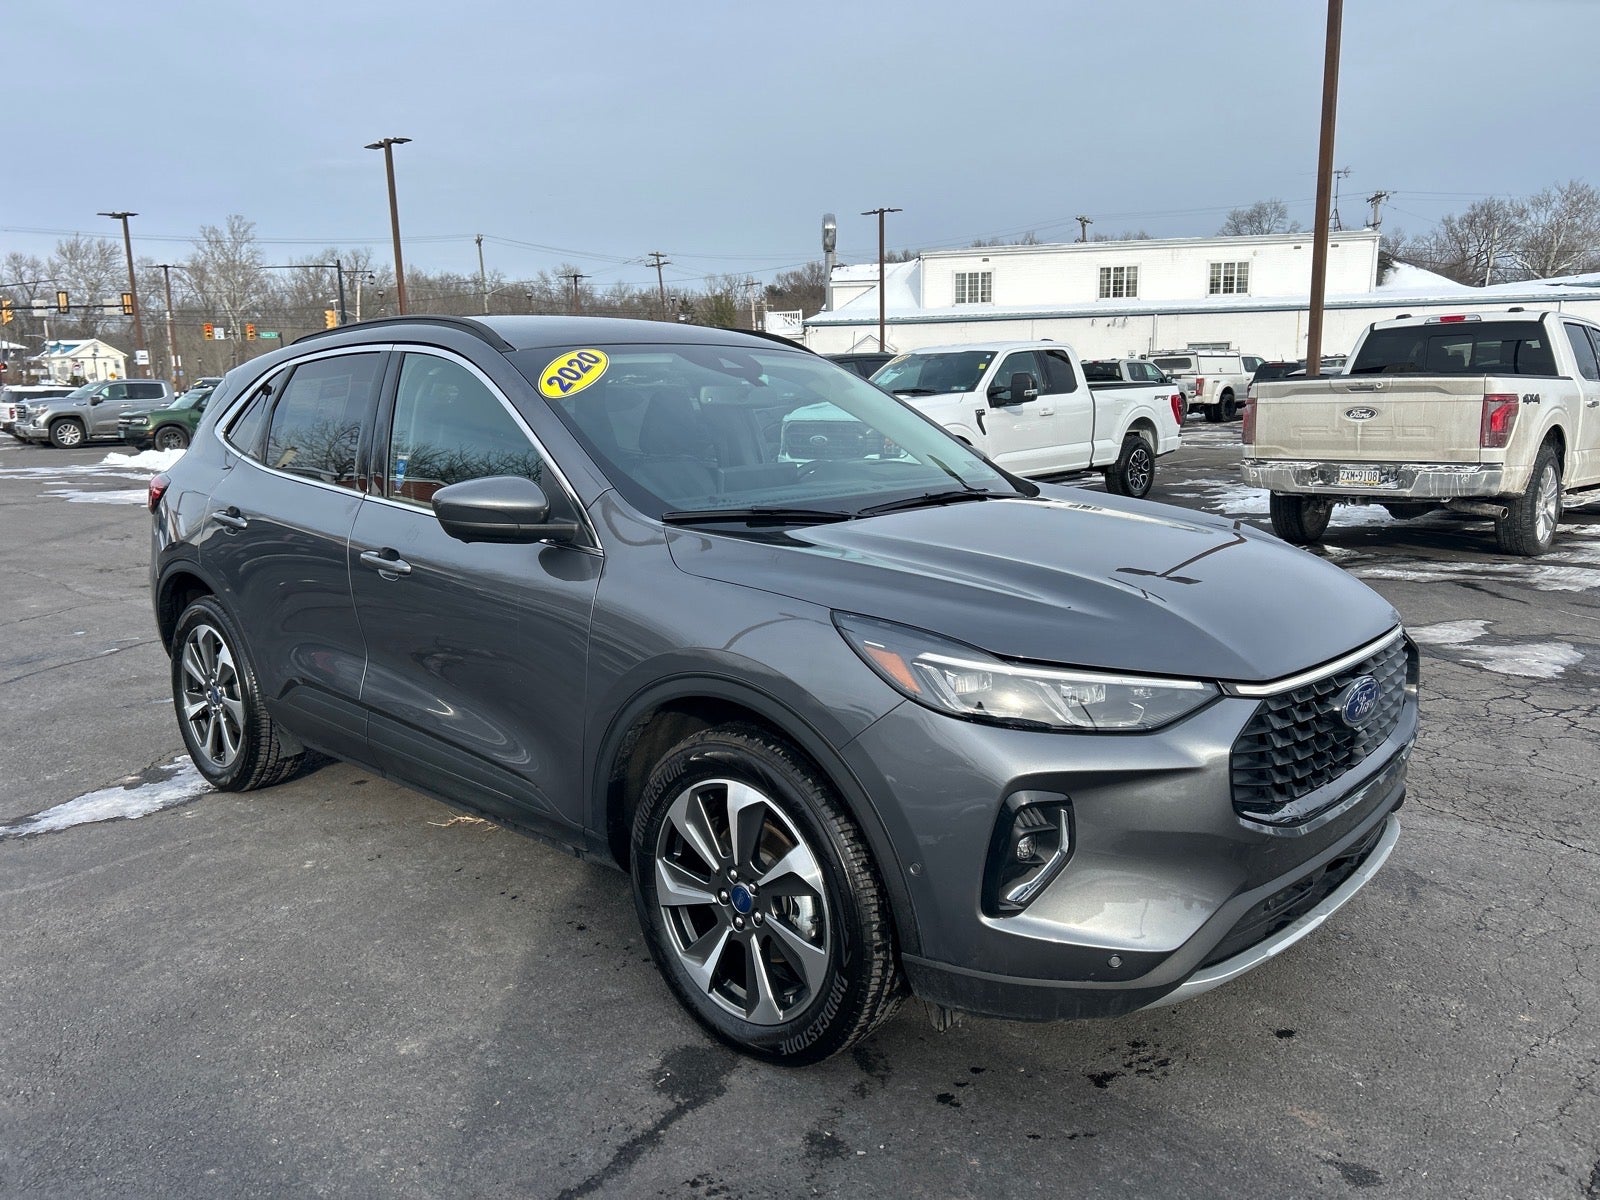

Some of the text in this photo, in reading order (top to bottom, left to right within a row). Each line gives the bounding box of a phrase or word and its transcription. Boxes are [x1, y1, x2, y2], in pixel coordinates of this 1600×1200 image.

[547, 352, 600, 393] 2020
[1349, 408, 1372, 419] Ford
[1354, 688, 1377, 717] Ford
[634, 757, 687, 846] BRIDGESTONE
[780, 972, 849, 1056] BRIDGESTONE
